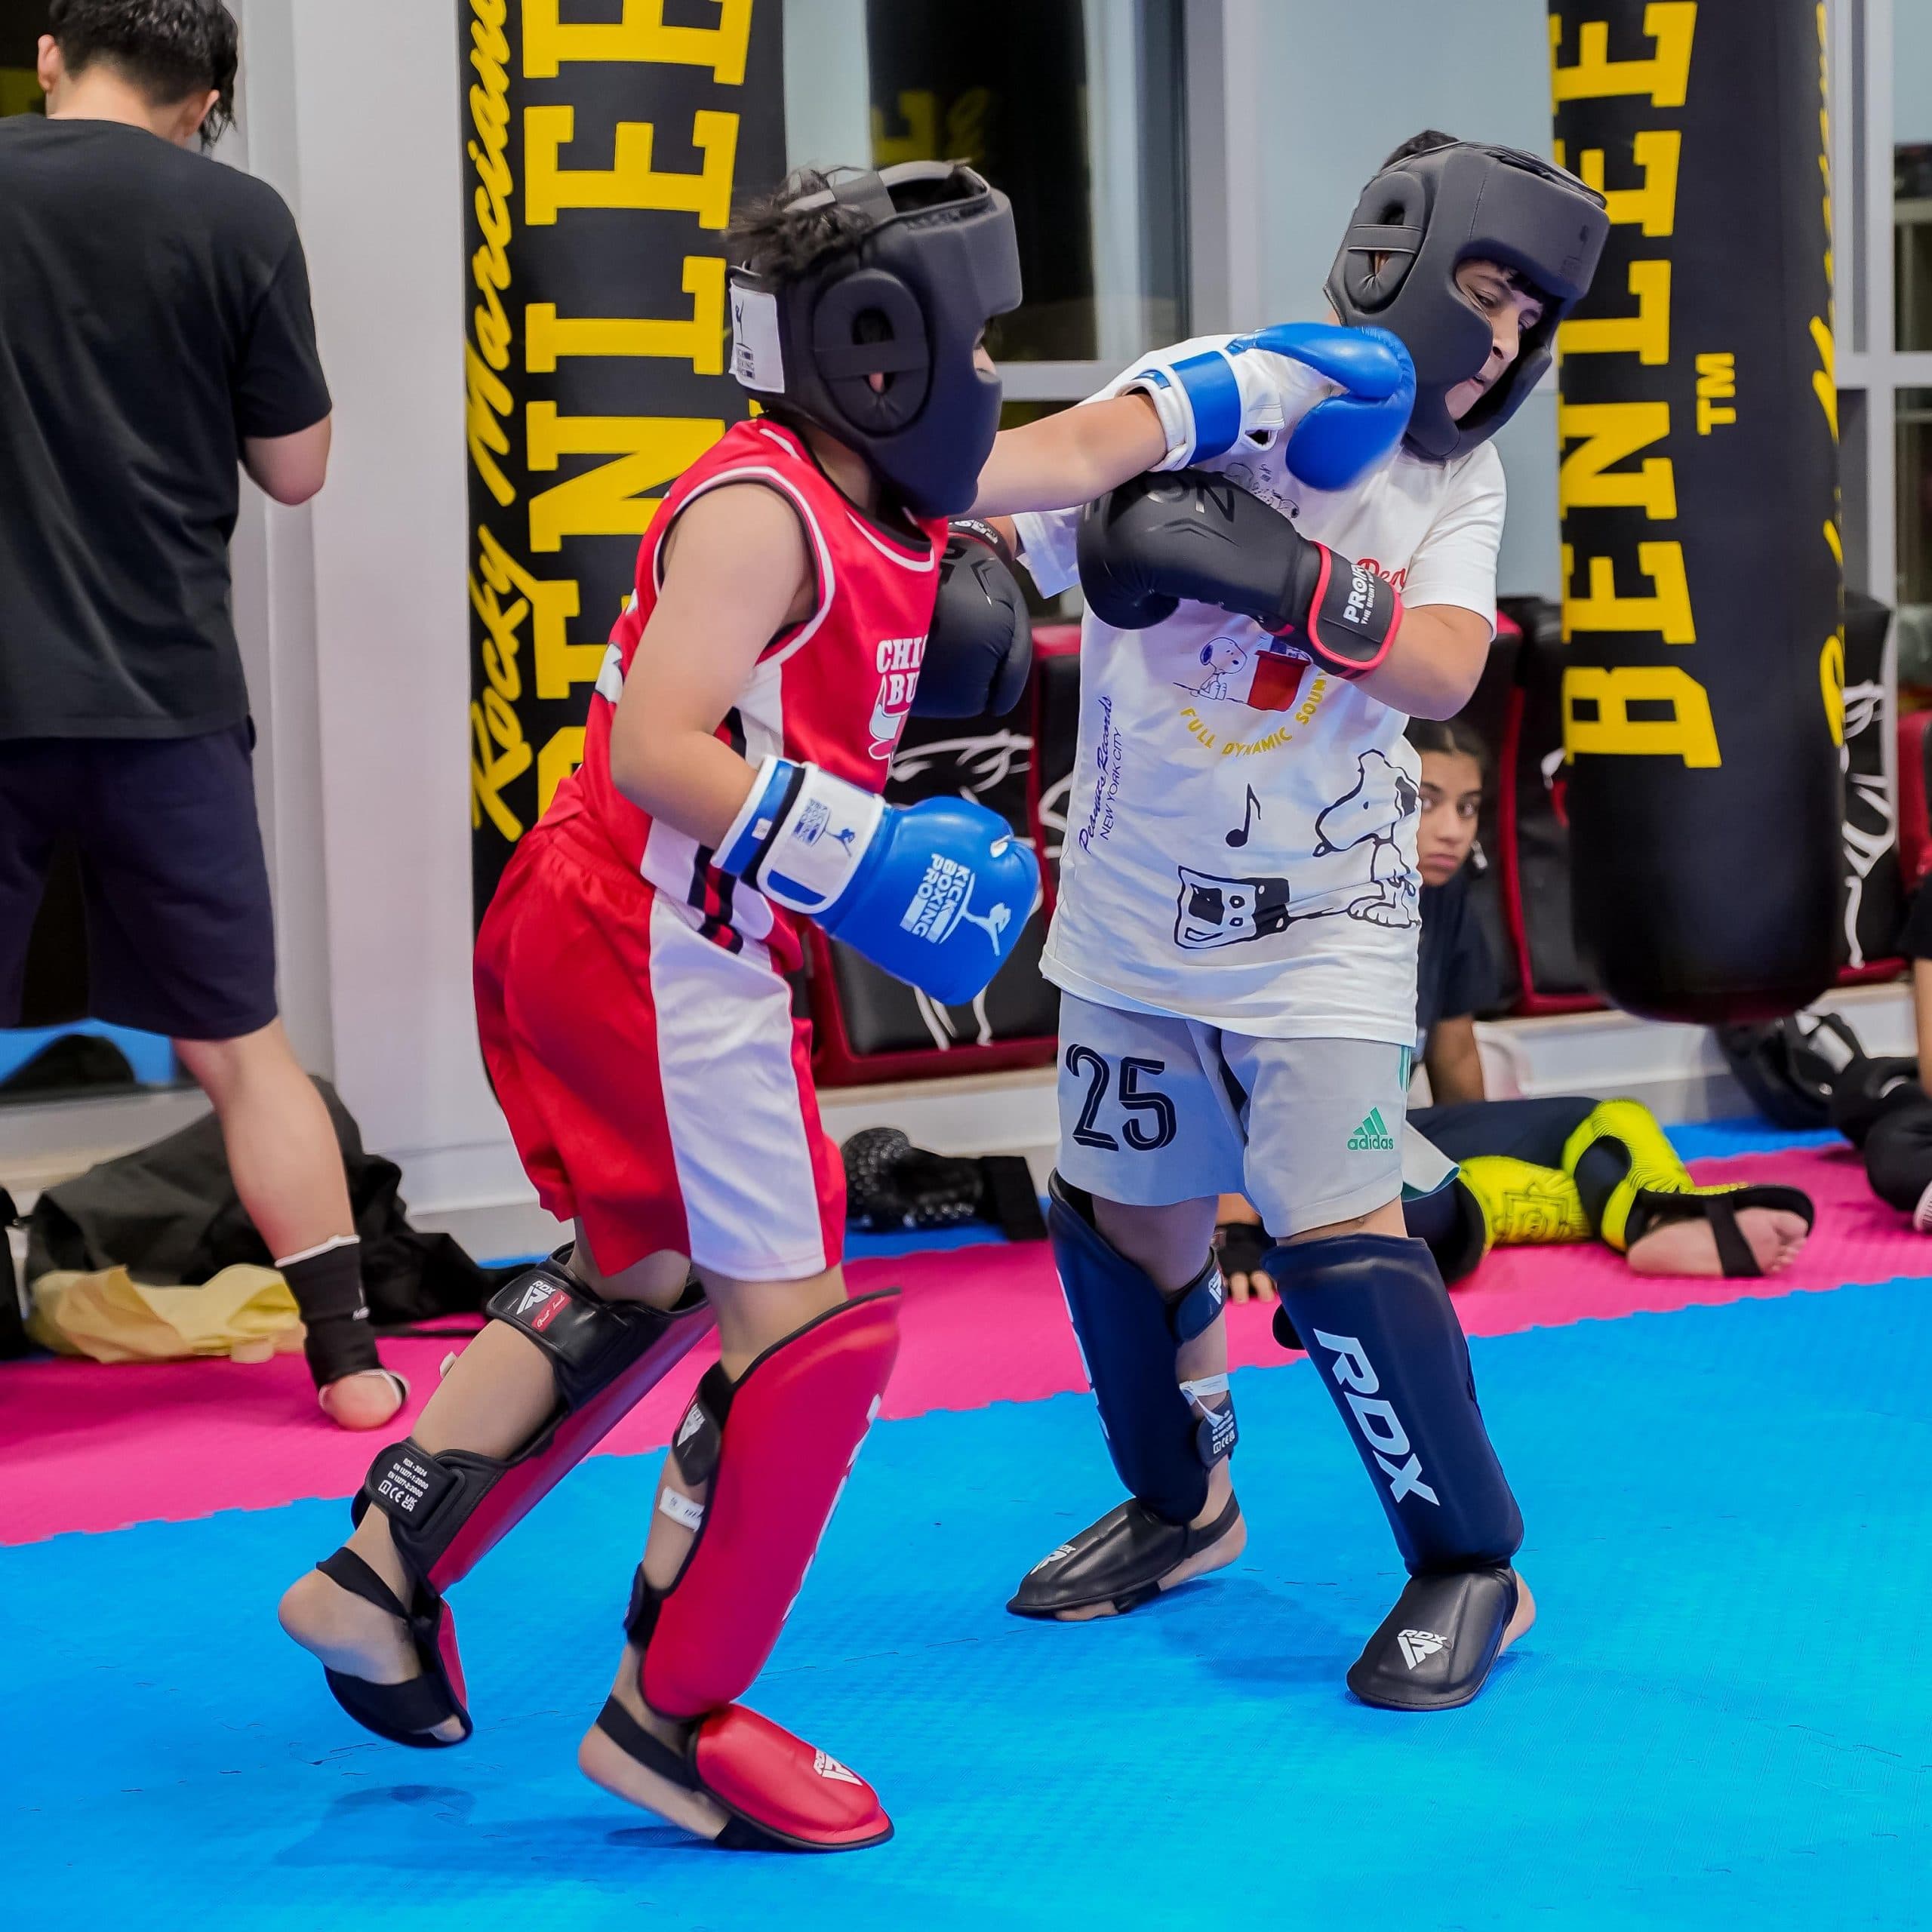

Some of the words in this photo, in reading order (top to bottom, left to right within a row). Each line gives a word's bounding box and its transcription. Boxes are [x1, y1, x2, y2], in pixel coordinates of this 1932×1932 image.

[1549, 2, 1722, 768] BENLEE
[1696, 352, 1737, 435] TM
[524, 0, 752, 830] NLEE
[876, 634, 928, 673] CHI
[469, 524, 534, 841] Rocky
[1180, 707, 1216, 749] FULL
[1221, 726, 1293, 757] DYNAMIC
[1295, 669, 1328, 725] SOUN
[1097, 696, 1112, 775] Records
[1112, 727, 1124, 761] CITY
[1107, 763, 1121, 801] YORK
[1100, 804, 1114, 841] NEW
[918, 853, 945, 899] PRO
[940, 865, 971, 912] KICK
[912, 858, 958, 937] BOXING
[1066, 1043, 1177, 1152] 25
[1346, 1134, 1394, 1151] adidas
[532, 1280, 557, 1295] RDX
[1312, 1327, 1441, 1507] RDX
[392, 1463, 401, 1472] EN
[402, 1457, 414, 1469] RDX
[414, 1465, 428, 1478] 2024
[389, 1487, 405, 1503] CE
[1059, 1544, 1077, 1554] DX
[1398, 1629, 1447, 1645] RDX
